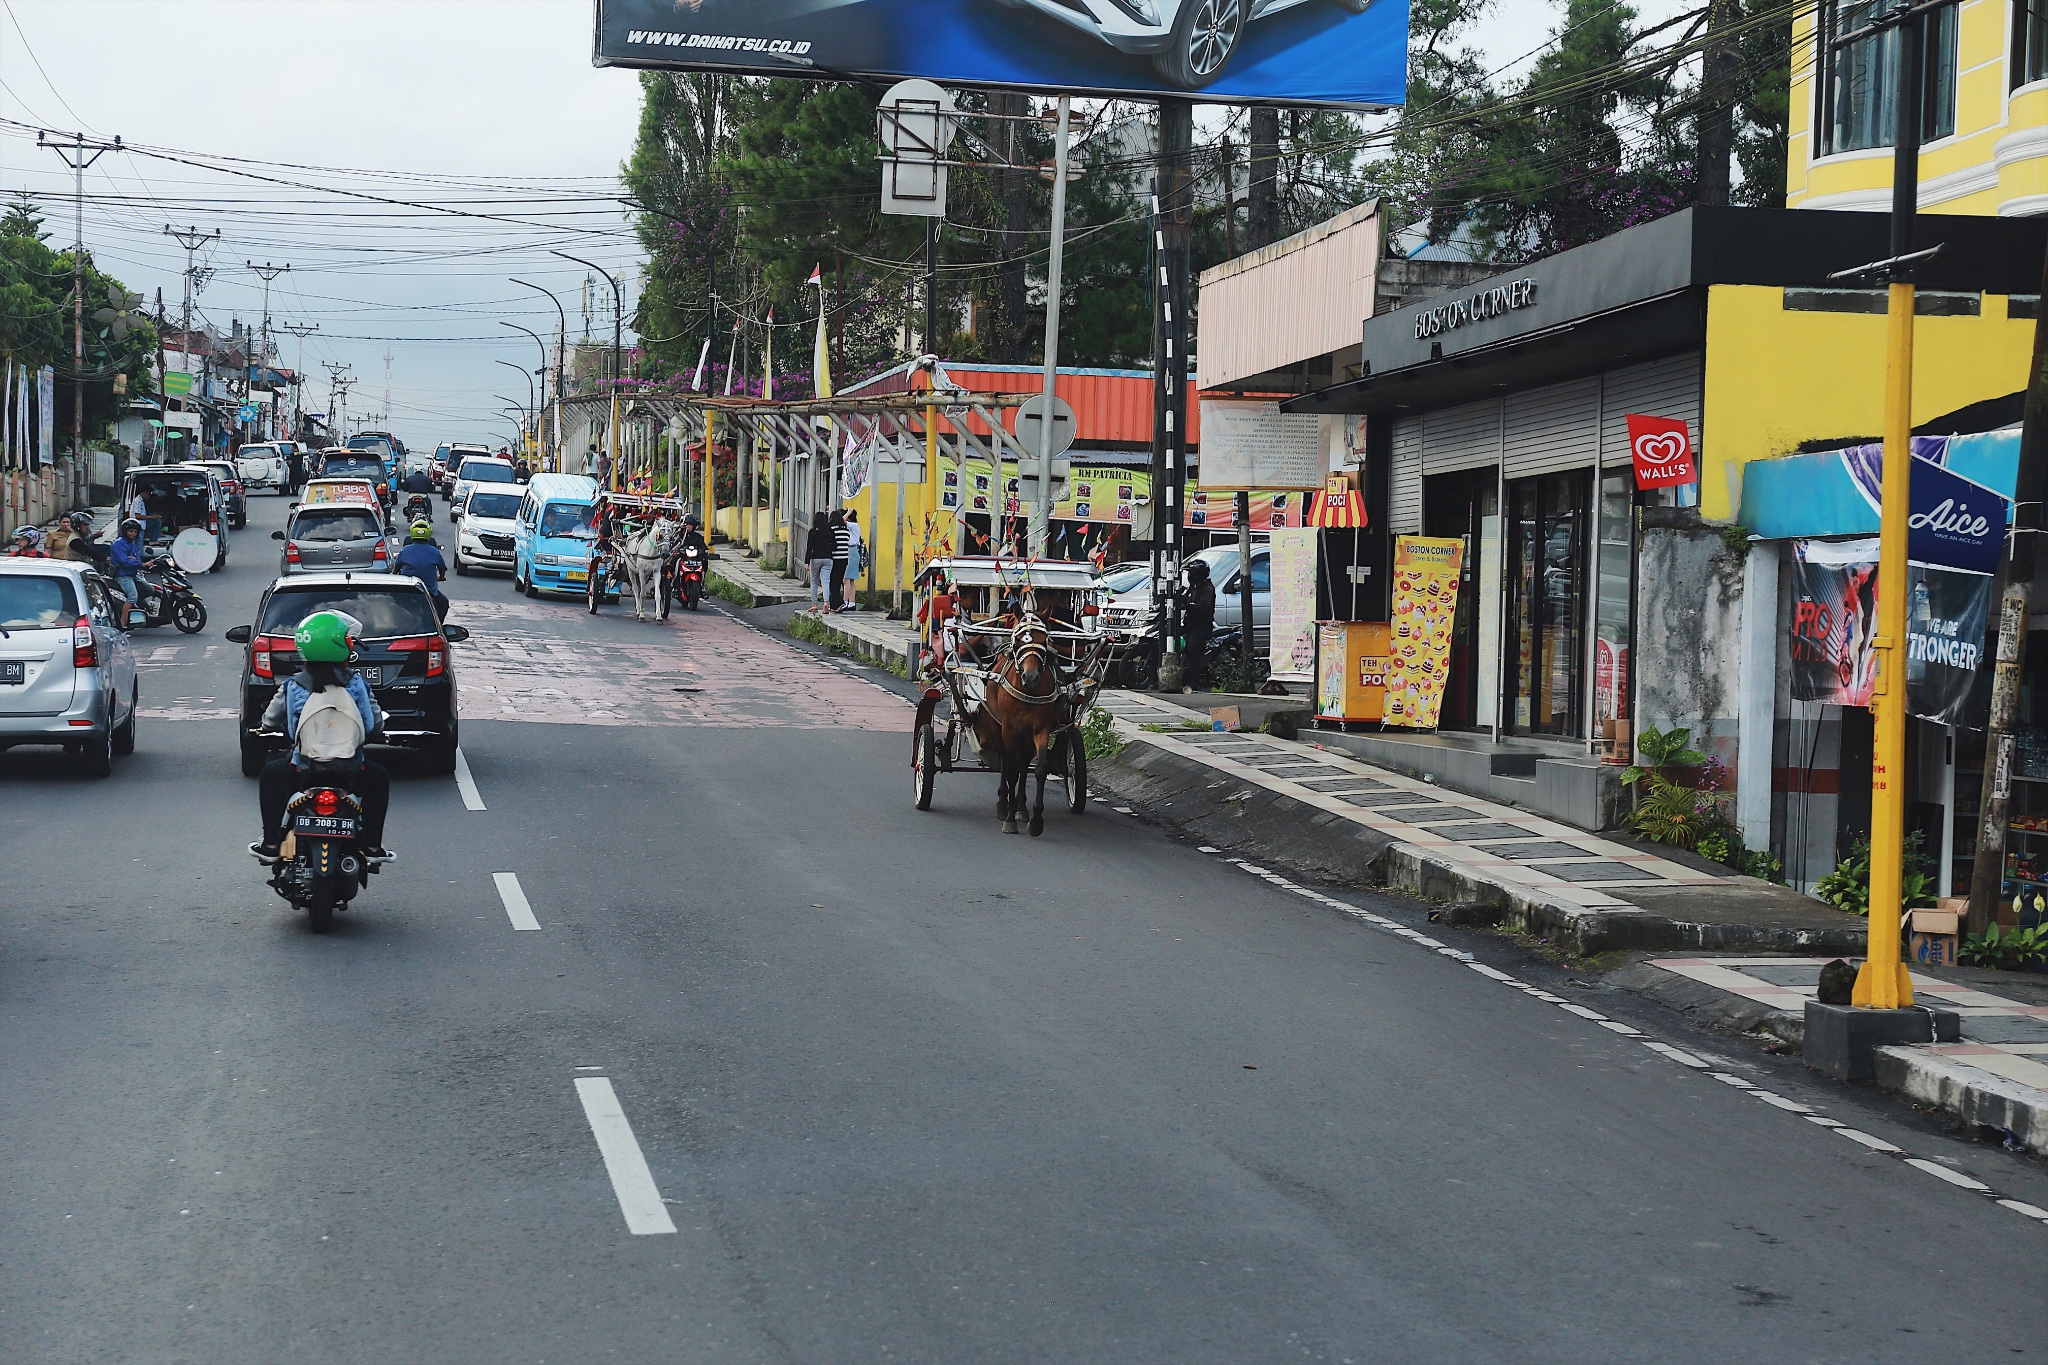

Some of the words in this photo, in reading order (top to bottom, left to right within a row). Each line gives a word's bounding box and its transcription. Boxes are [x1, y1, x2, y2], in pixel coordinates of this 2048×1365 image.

[626, 29, 812, 54] WWW.DAIHATSU.CO.ID
[1414, 299, 1468, 339] BOSTON
[1470, 277, 1534, 321] CORNER
[1078, 468, 1090, 479] RM
[1093, 469, 1133, 481] PATRICIA
[1639, 463, 1688, 480] WALL'S
[1327, 495, 1346, 506] POCI
[1908, 498, 1990, 537] Aice
[1406, 545, 1430, 555] BOSTON
[1430, 546, 1456, 556] CORNER
[2010, 598, 2023, 612] WC
[1793, 602, 1832, 640] PRO
[1940, 619, 1959, 637] ARE
[1905, 631, 1977, 672] TRONGER
[6, 664, 20, 676] BM
[1362, 659, 1377, 667] TEH
[366, 668, 378, 679] GE
[300, 818, 310, 826] DB
[315, 818, 337, 828] 3083
